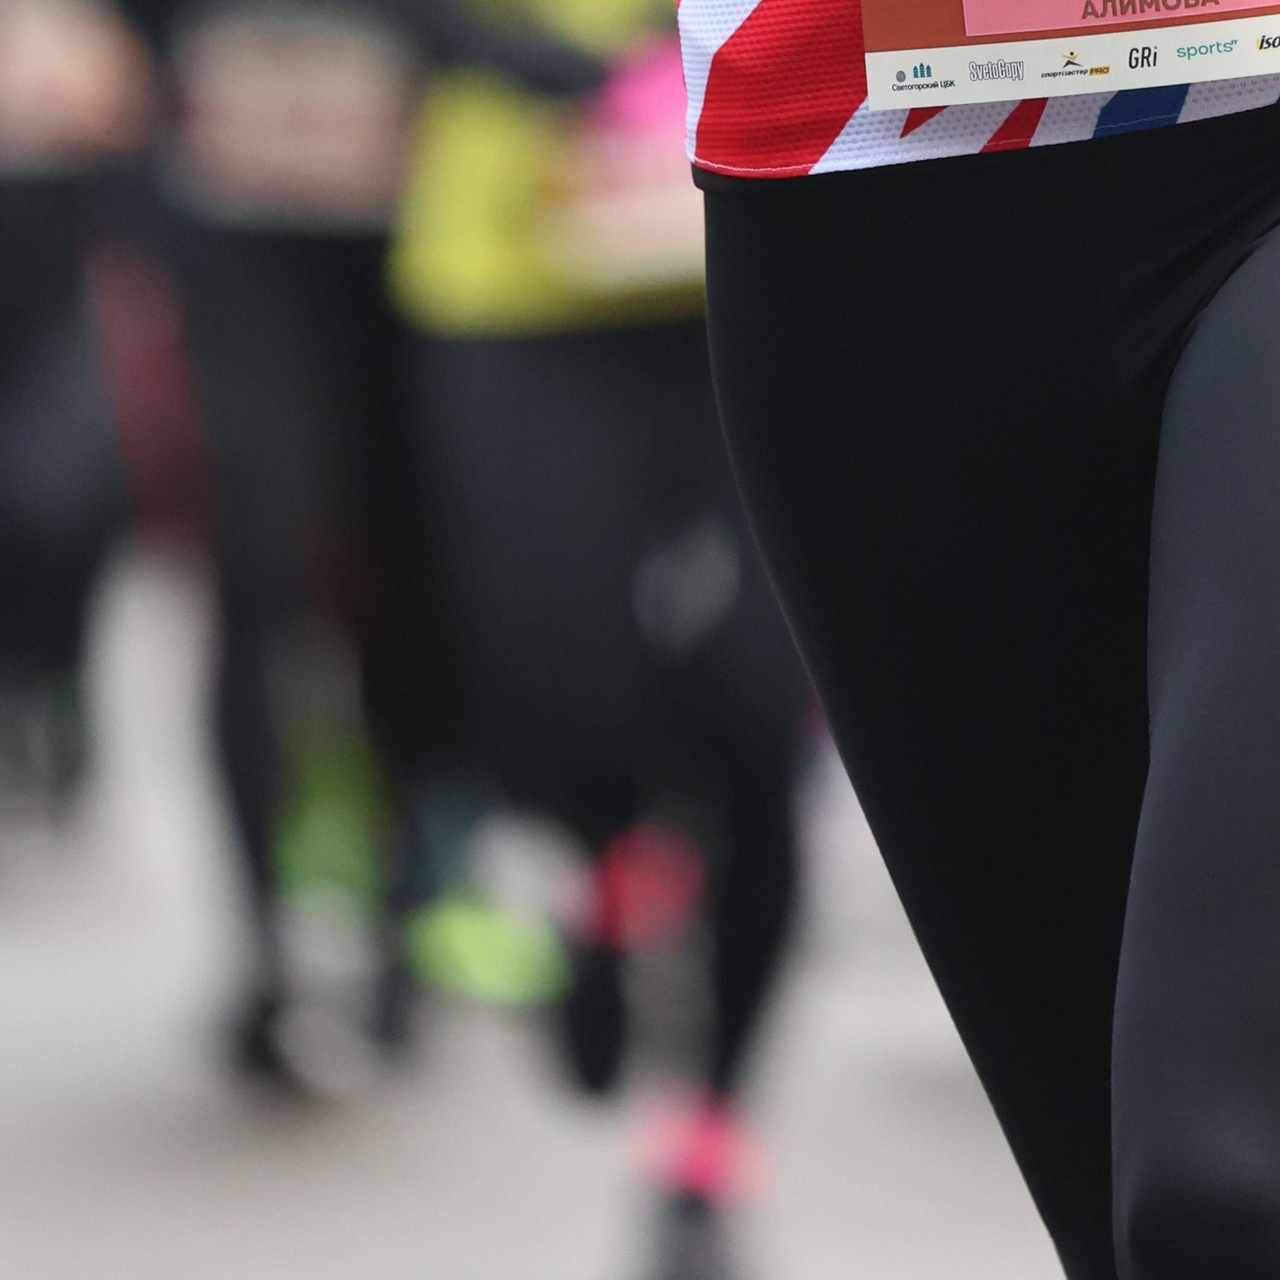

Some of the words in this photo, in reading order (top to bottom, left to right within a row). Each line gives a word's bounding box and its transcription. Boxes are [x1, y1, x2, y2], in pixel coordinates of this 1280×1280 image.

[1128, 47, 1158, 69] GRi
[969, 58, 1024, 81] SvetoCopy
[1090, 67, 1110, 75] PRO
[892, 81, 939, 91] Светогорский
[940, 80, 955, 89] ЦБК
